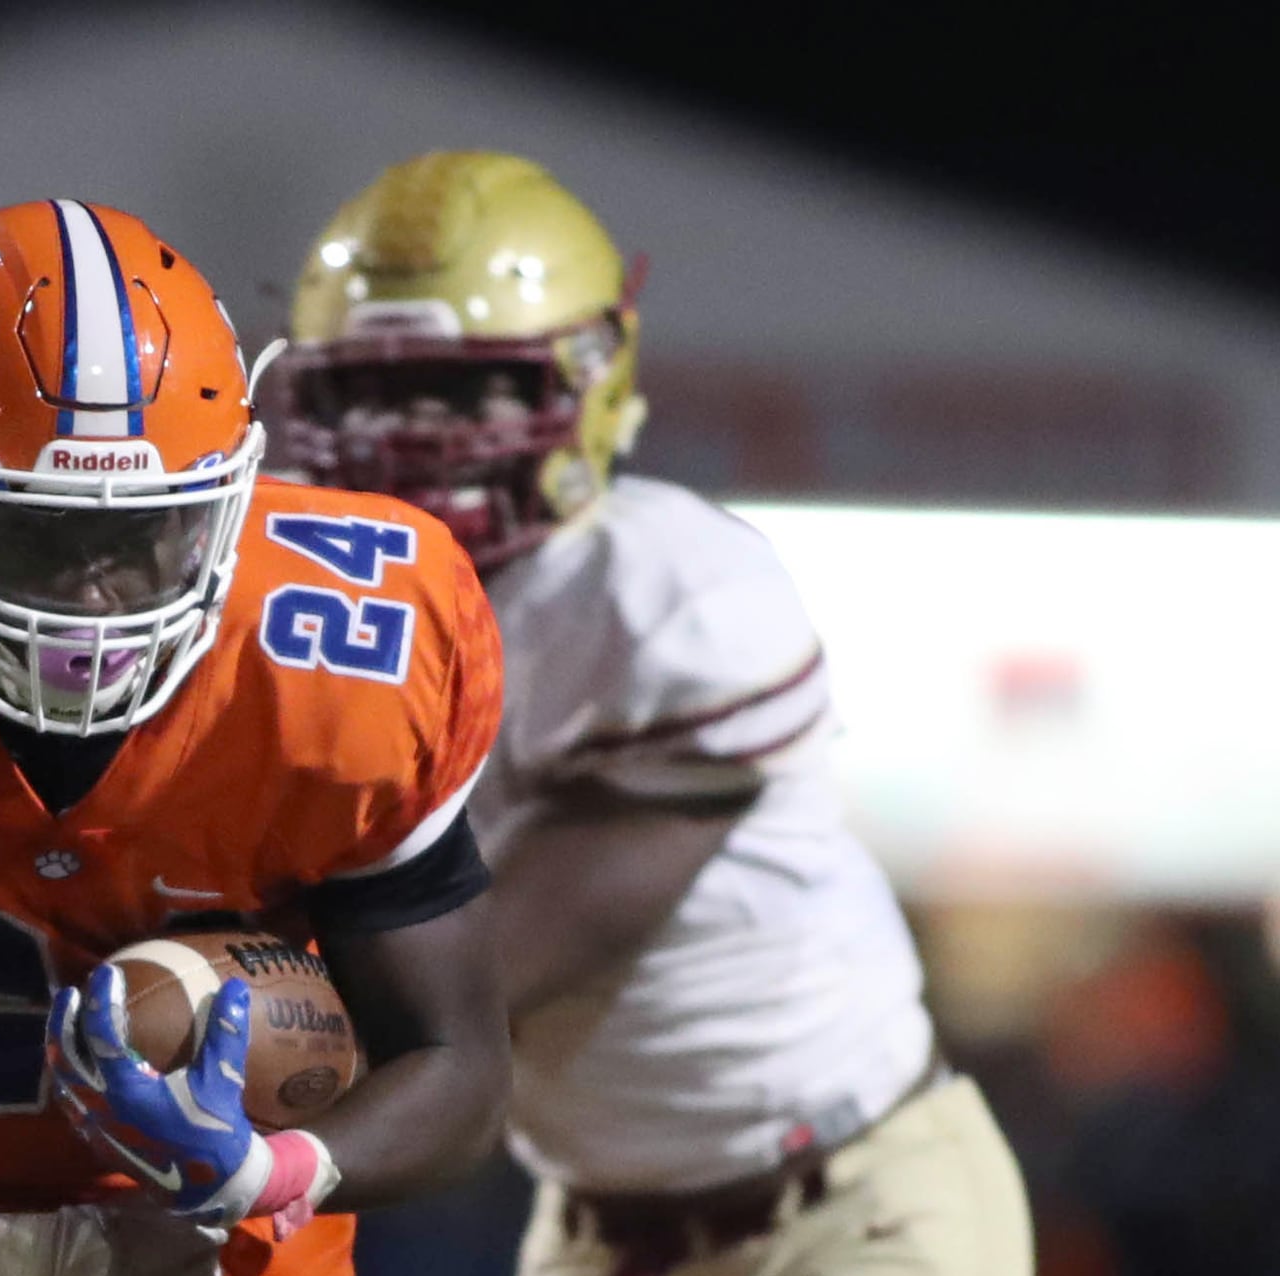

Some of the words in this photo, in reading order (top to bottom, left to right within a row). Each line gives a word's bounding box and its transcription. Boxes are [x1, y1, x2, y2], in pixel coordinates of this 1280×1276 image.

[51, 449, 149, 471] Riddell
[260, 511, 418, 685] 24
[264, 996, 347, 1034] Wilson
